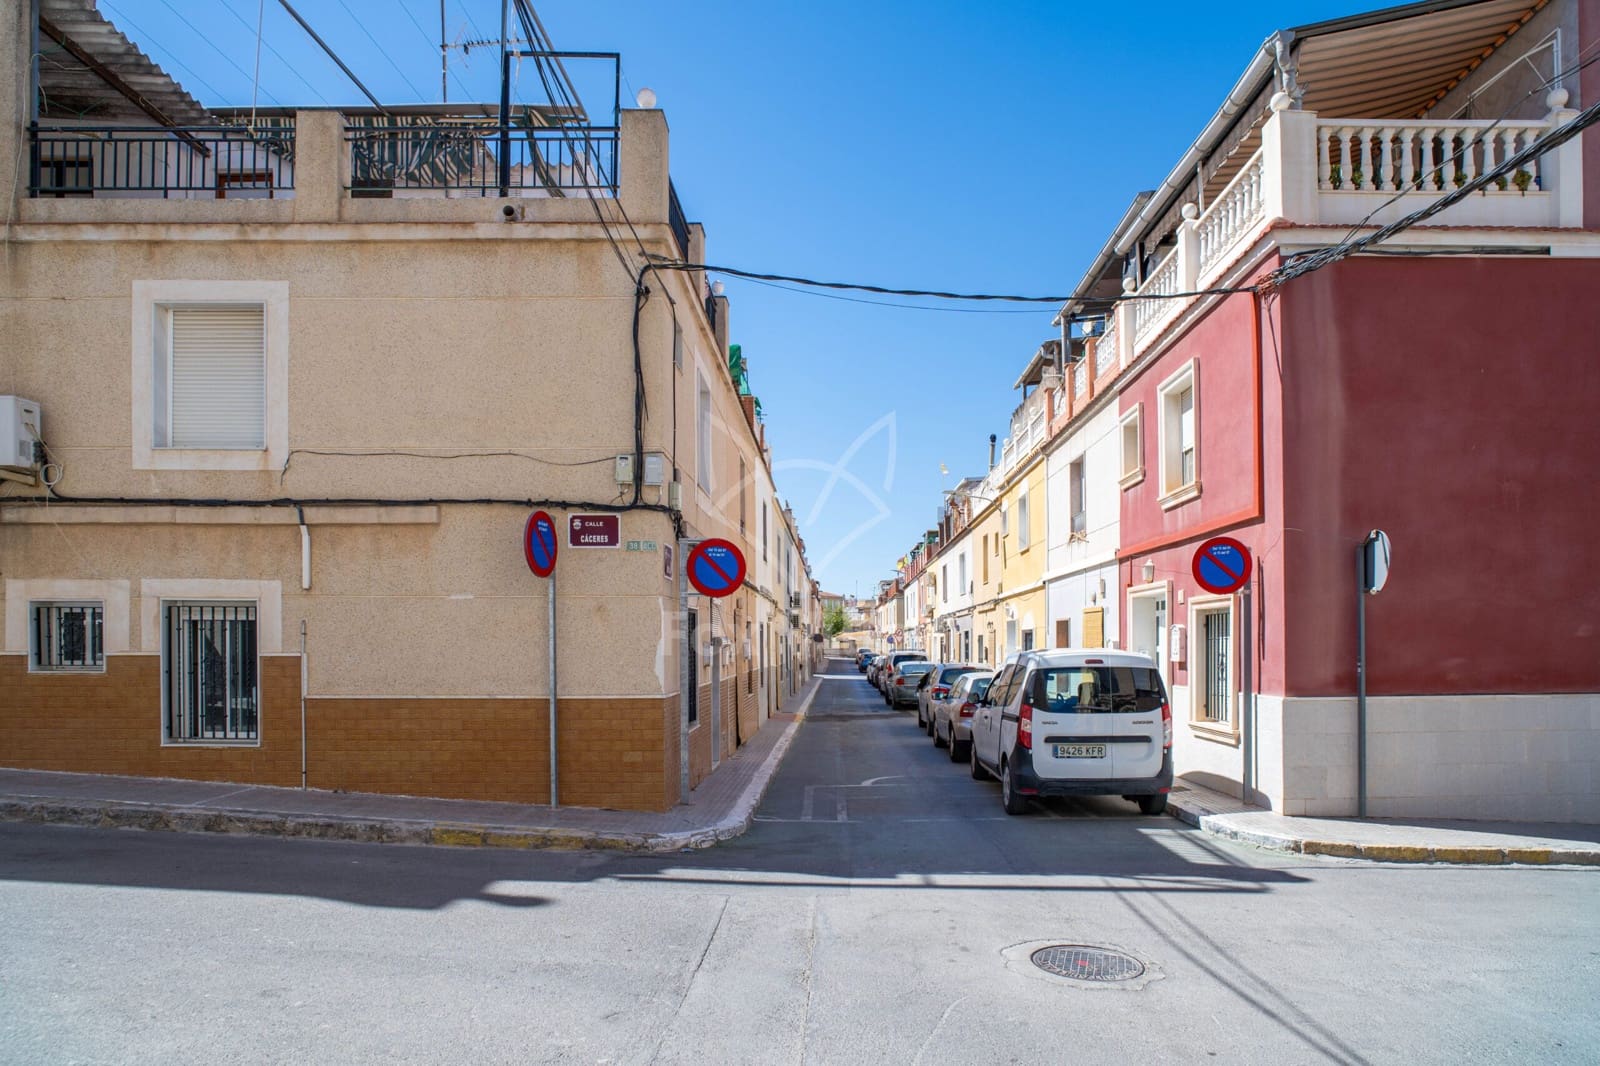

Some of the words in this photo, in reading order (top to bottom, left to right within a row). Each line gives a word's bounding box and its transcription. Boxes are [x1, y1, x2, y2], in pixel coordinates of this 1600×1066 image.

[580, 533, 609, 543] CÁCERES
[1060, 746, 1083, 756] 9426
[1086, 746, 1104, 756] KFR
